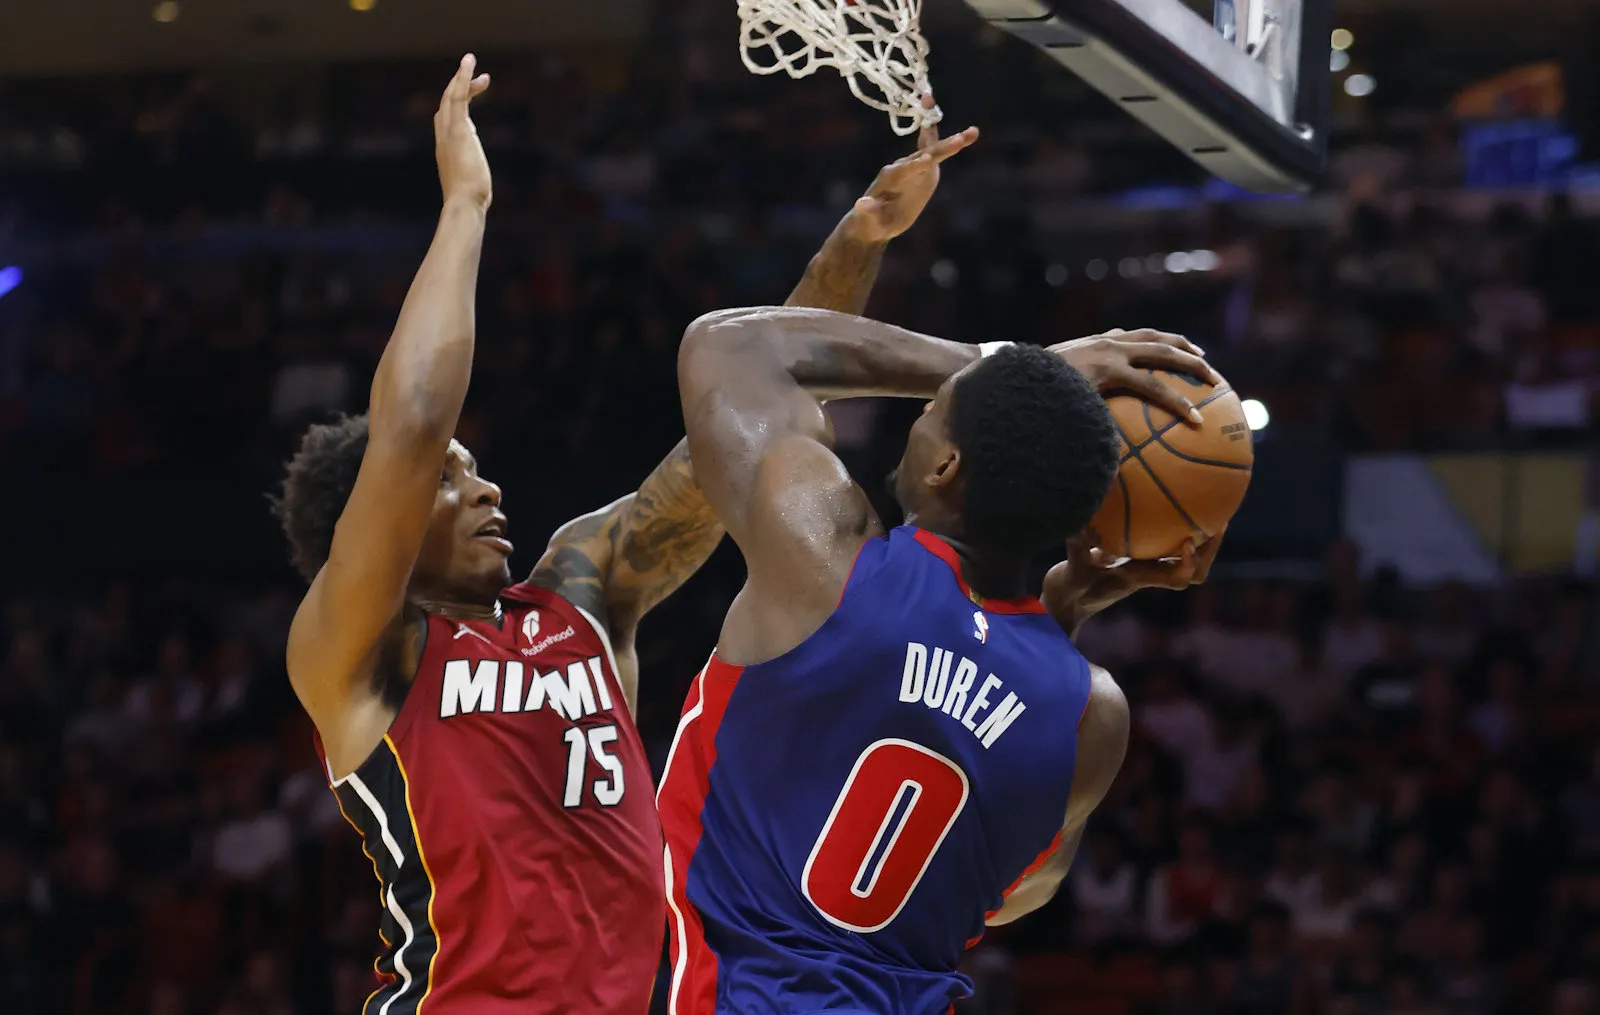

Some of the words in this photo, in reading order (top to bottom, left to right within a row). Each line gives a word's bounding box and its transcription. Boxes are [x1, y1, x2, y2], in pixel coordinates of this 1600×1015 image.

[521, 626, 576, 657] Robinhood
[439, 655, 614, 722] MIAMI
[898, 641, 1027, 750] DUREN
[562, 724, 625, 809] 15
[800, 738, 970, 934] 0
